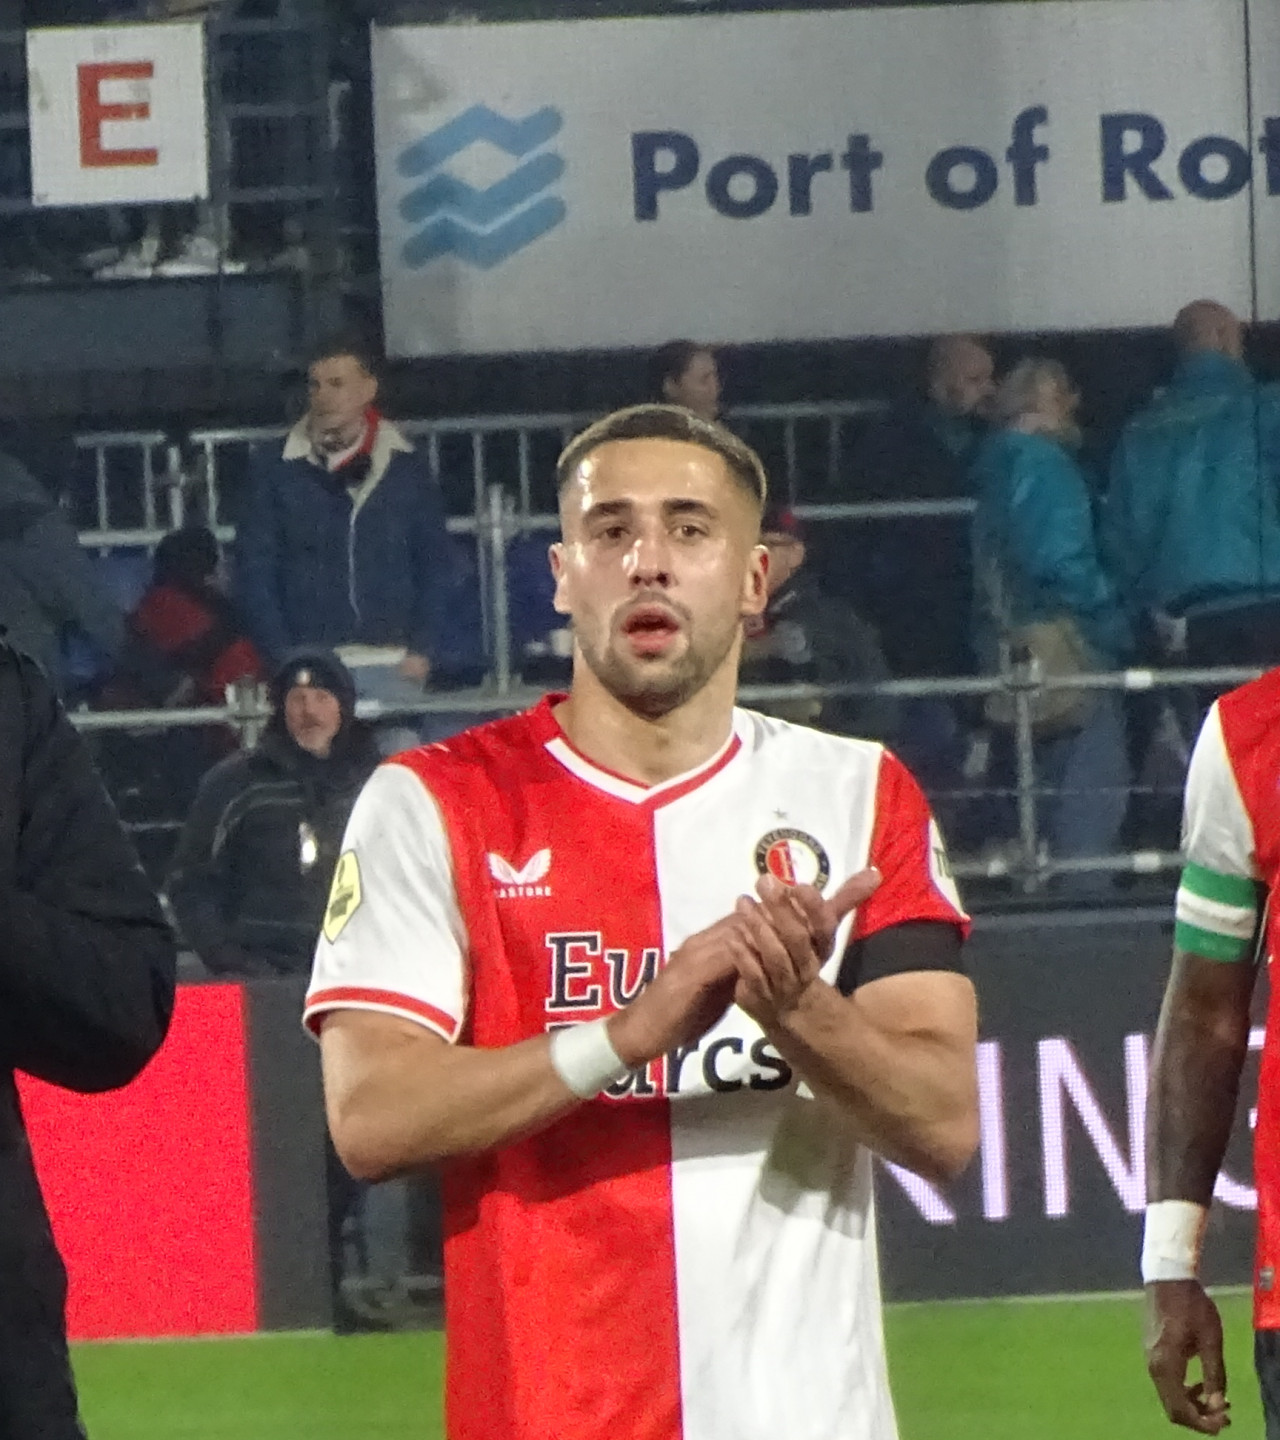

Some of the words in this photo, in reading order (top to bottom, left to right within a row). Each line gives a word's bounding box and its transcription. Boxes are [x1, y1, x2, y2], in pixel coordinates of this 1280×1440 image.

[77, 61, 159, 168] E
[630, 130, 884, 222] Port
[926, 104, 1049, 209] of
